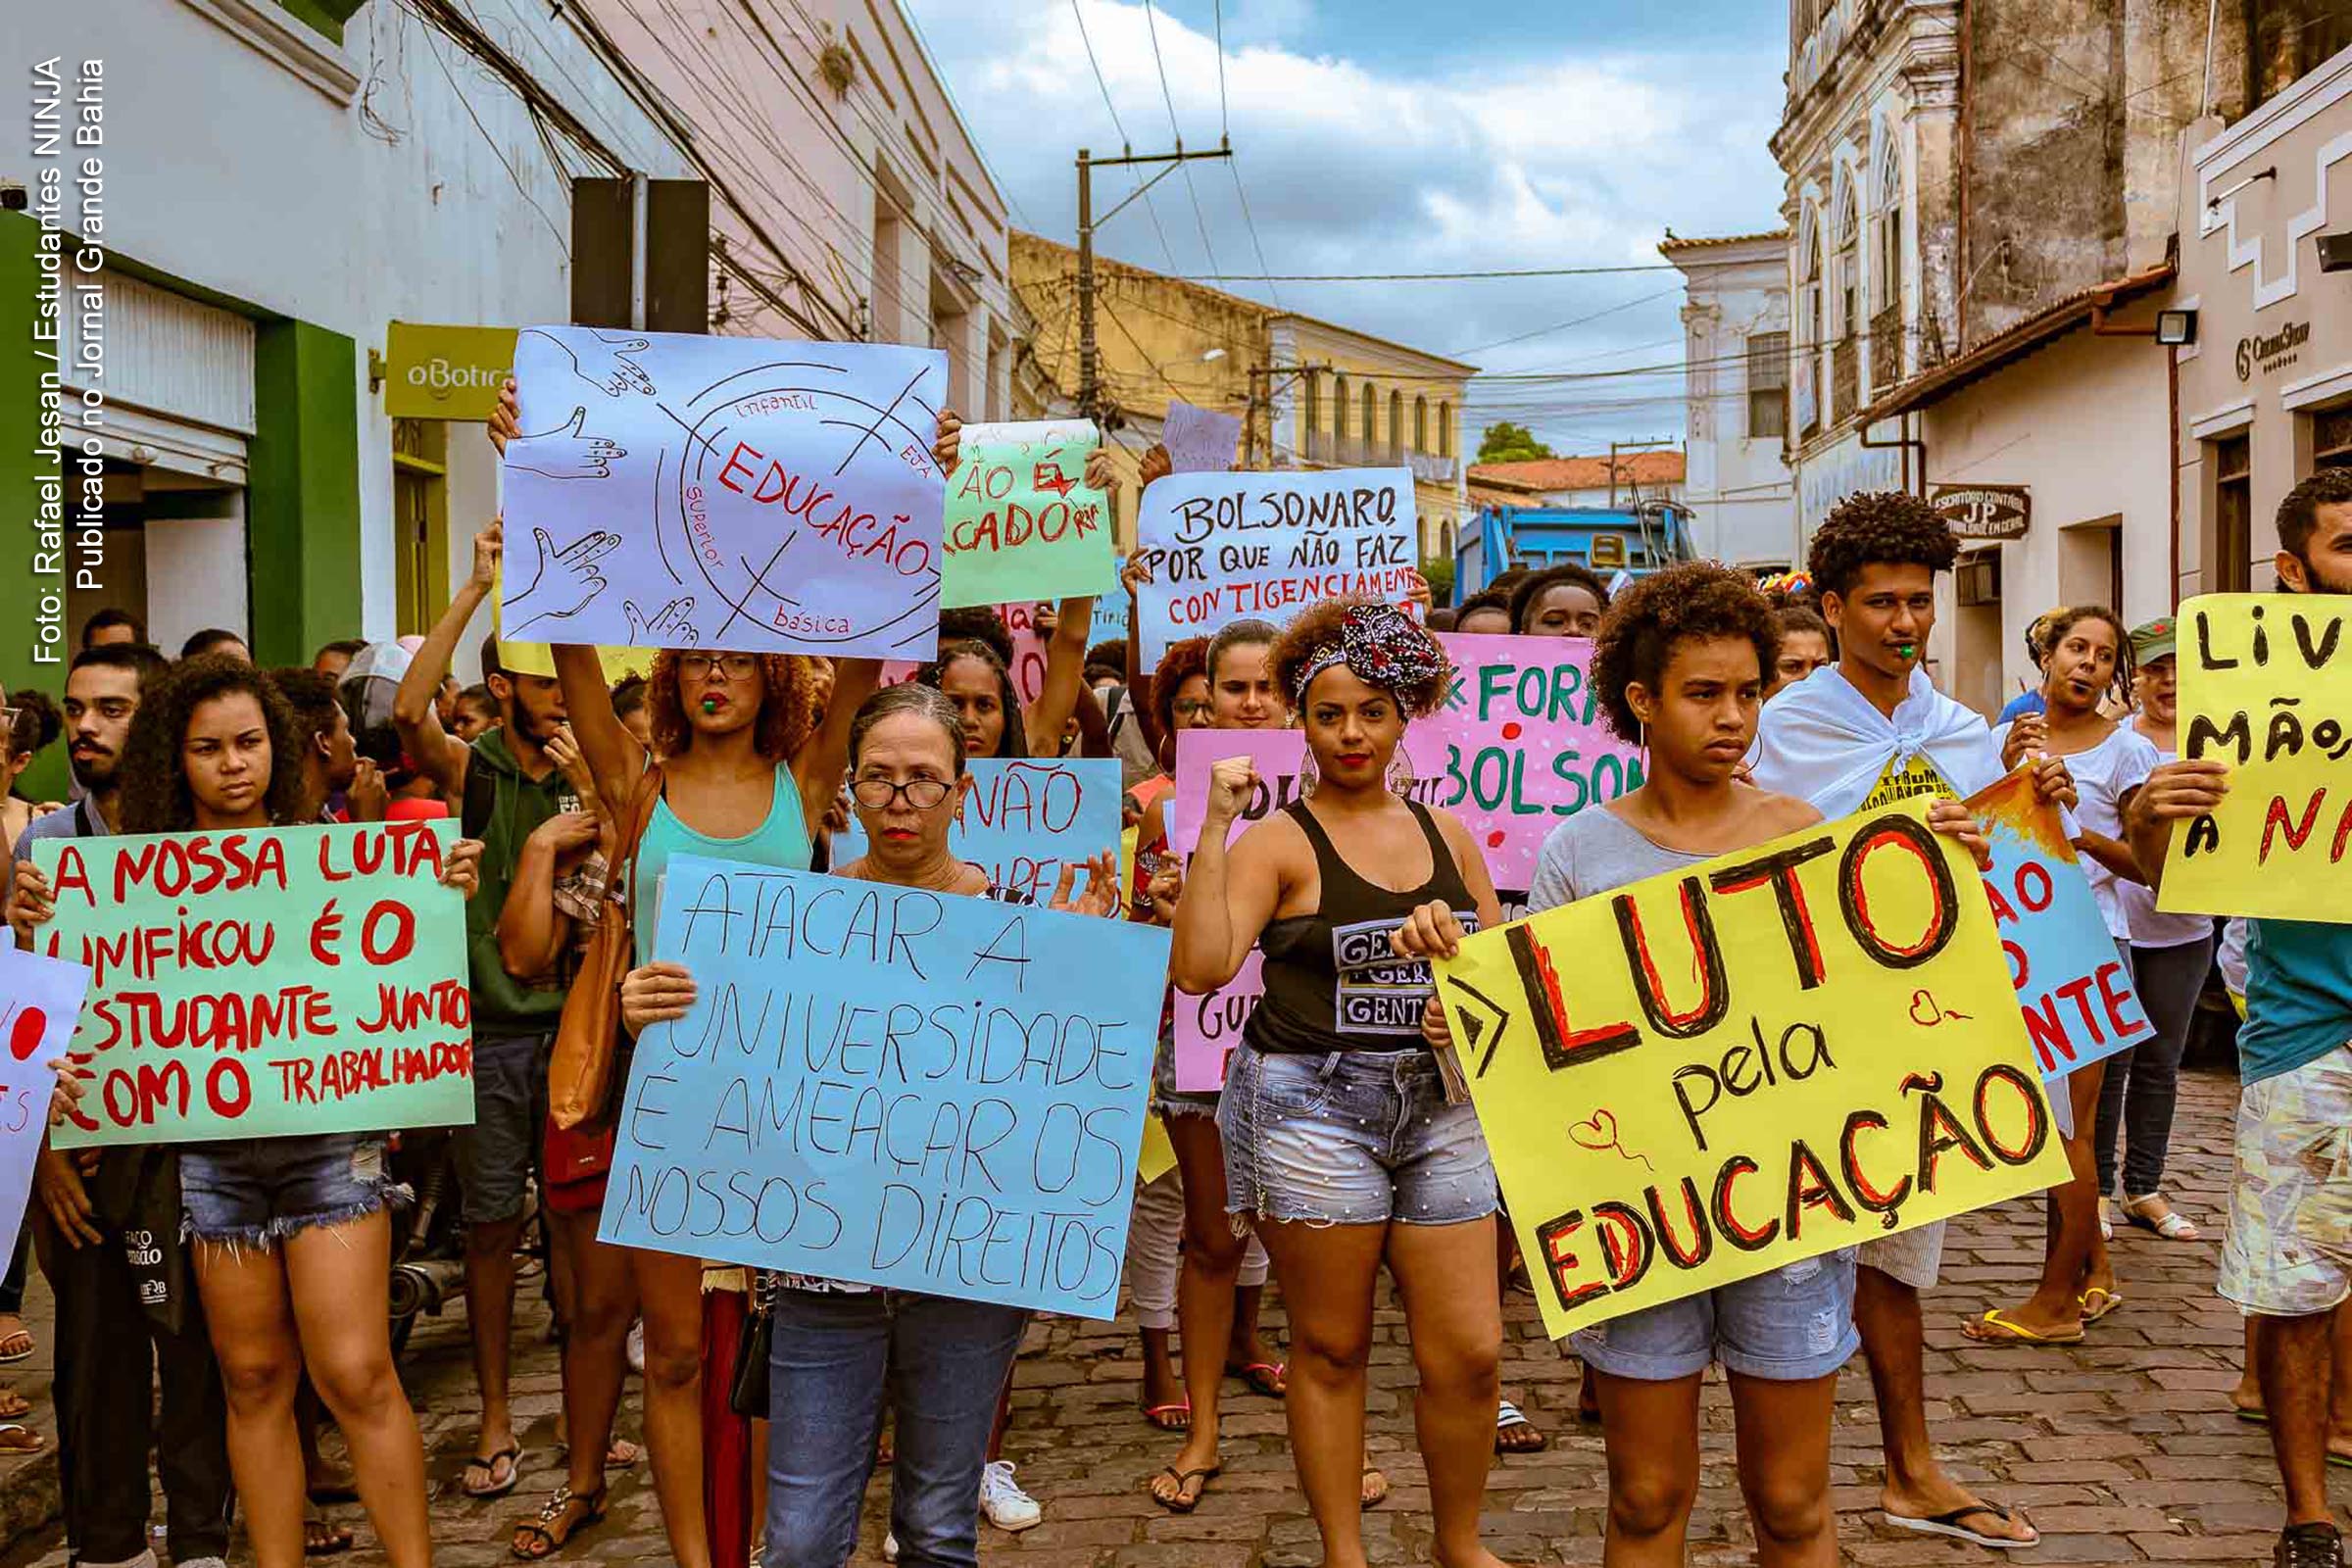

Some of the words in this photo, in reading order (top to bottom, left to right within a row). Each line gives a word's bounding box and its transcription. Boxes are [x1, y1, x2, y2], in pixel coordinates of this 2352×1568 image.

[901, 444, 933, 479] EJA
[718, 441, 929, 576] EDUCAÇÃO
[1170, 486, 1396, 545] BOLSONARO,
[1143, 546, 1207, 584] POR
[1219, 545, 1271, 572] QUE
[1288, 530, 1341, 569] NÃO
[1356, 534, 1409, 568] FAZ
[773, 605, 850, 636] básica
[960, 760, 1083, 839] NÃO
[2183, 811, 2220, 858] A
[51, 846, 96, 907] A
[113, 835, 288, 905] NOSSA
[318, 819, 443, 882] LUTA
[309, 898, 345, 966] É
[360, 899, 416, 966] O
[681, 871, 944, 982] ATACAR
[964, 915, 1033, 993] A
[1504, 812, 1960, 1074] LUTO
[356, 978, 471, 1036] JUNTO
[1347, 997, 1424, 1026] GENT
[2021, 960, 2146, 1073] NTE
[205, 1056, 253, 1120] O
[1672, 1014, 1838, 1153] pela
[630, 1059, 679, 1152] É
[704, 1076, 1018, 1195] AMEAÇAR
[1033, 1102, 1132, 1207] OS
[613, 1163, 845, 1251] NOSSOS
[1534, 1063, 2050, 1313] EDUCAÇÃO
